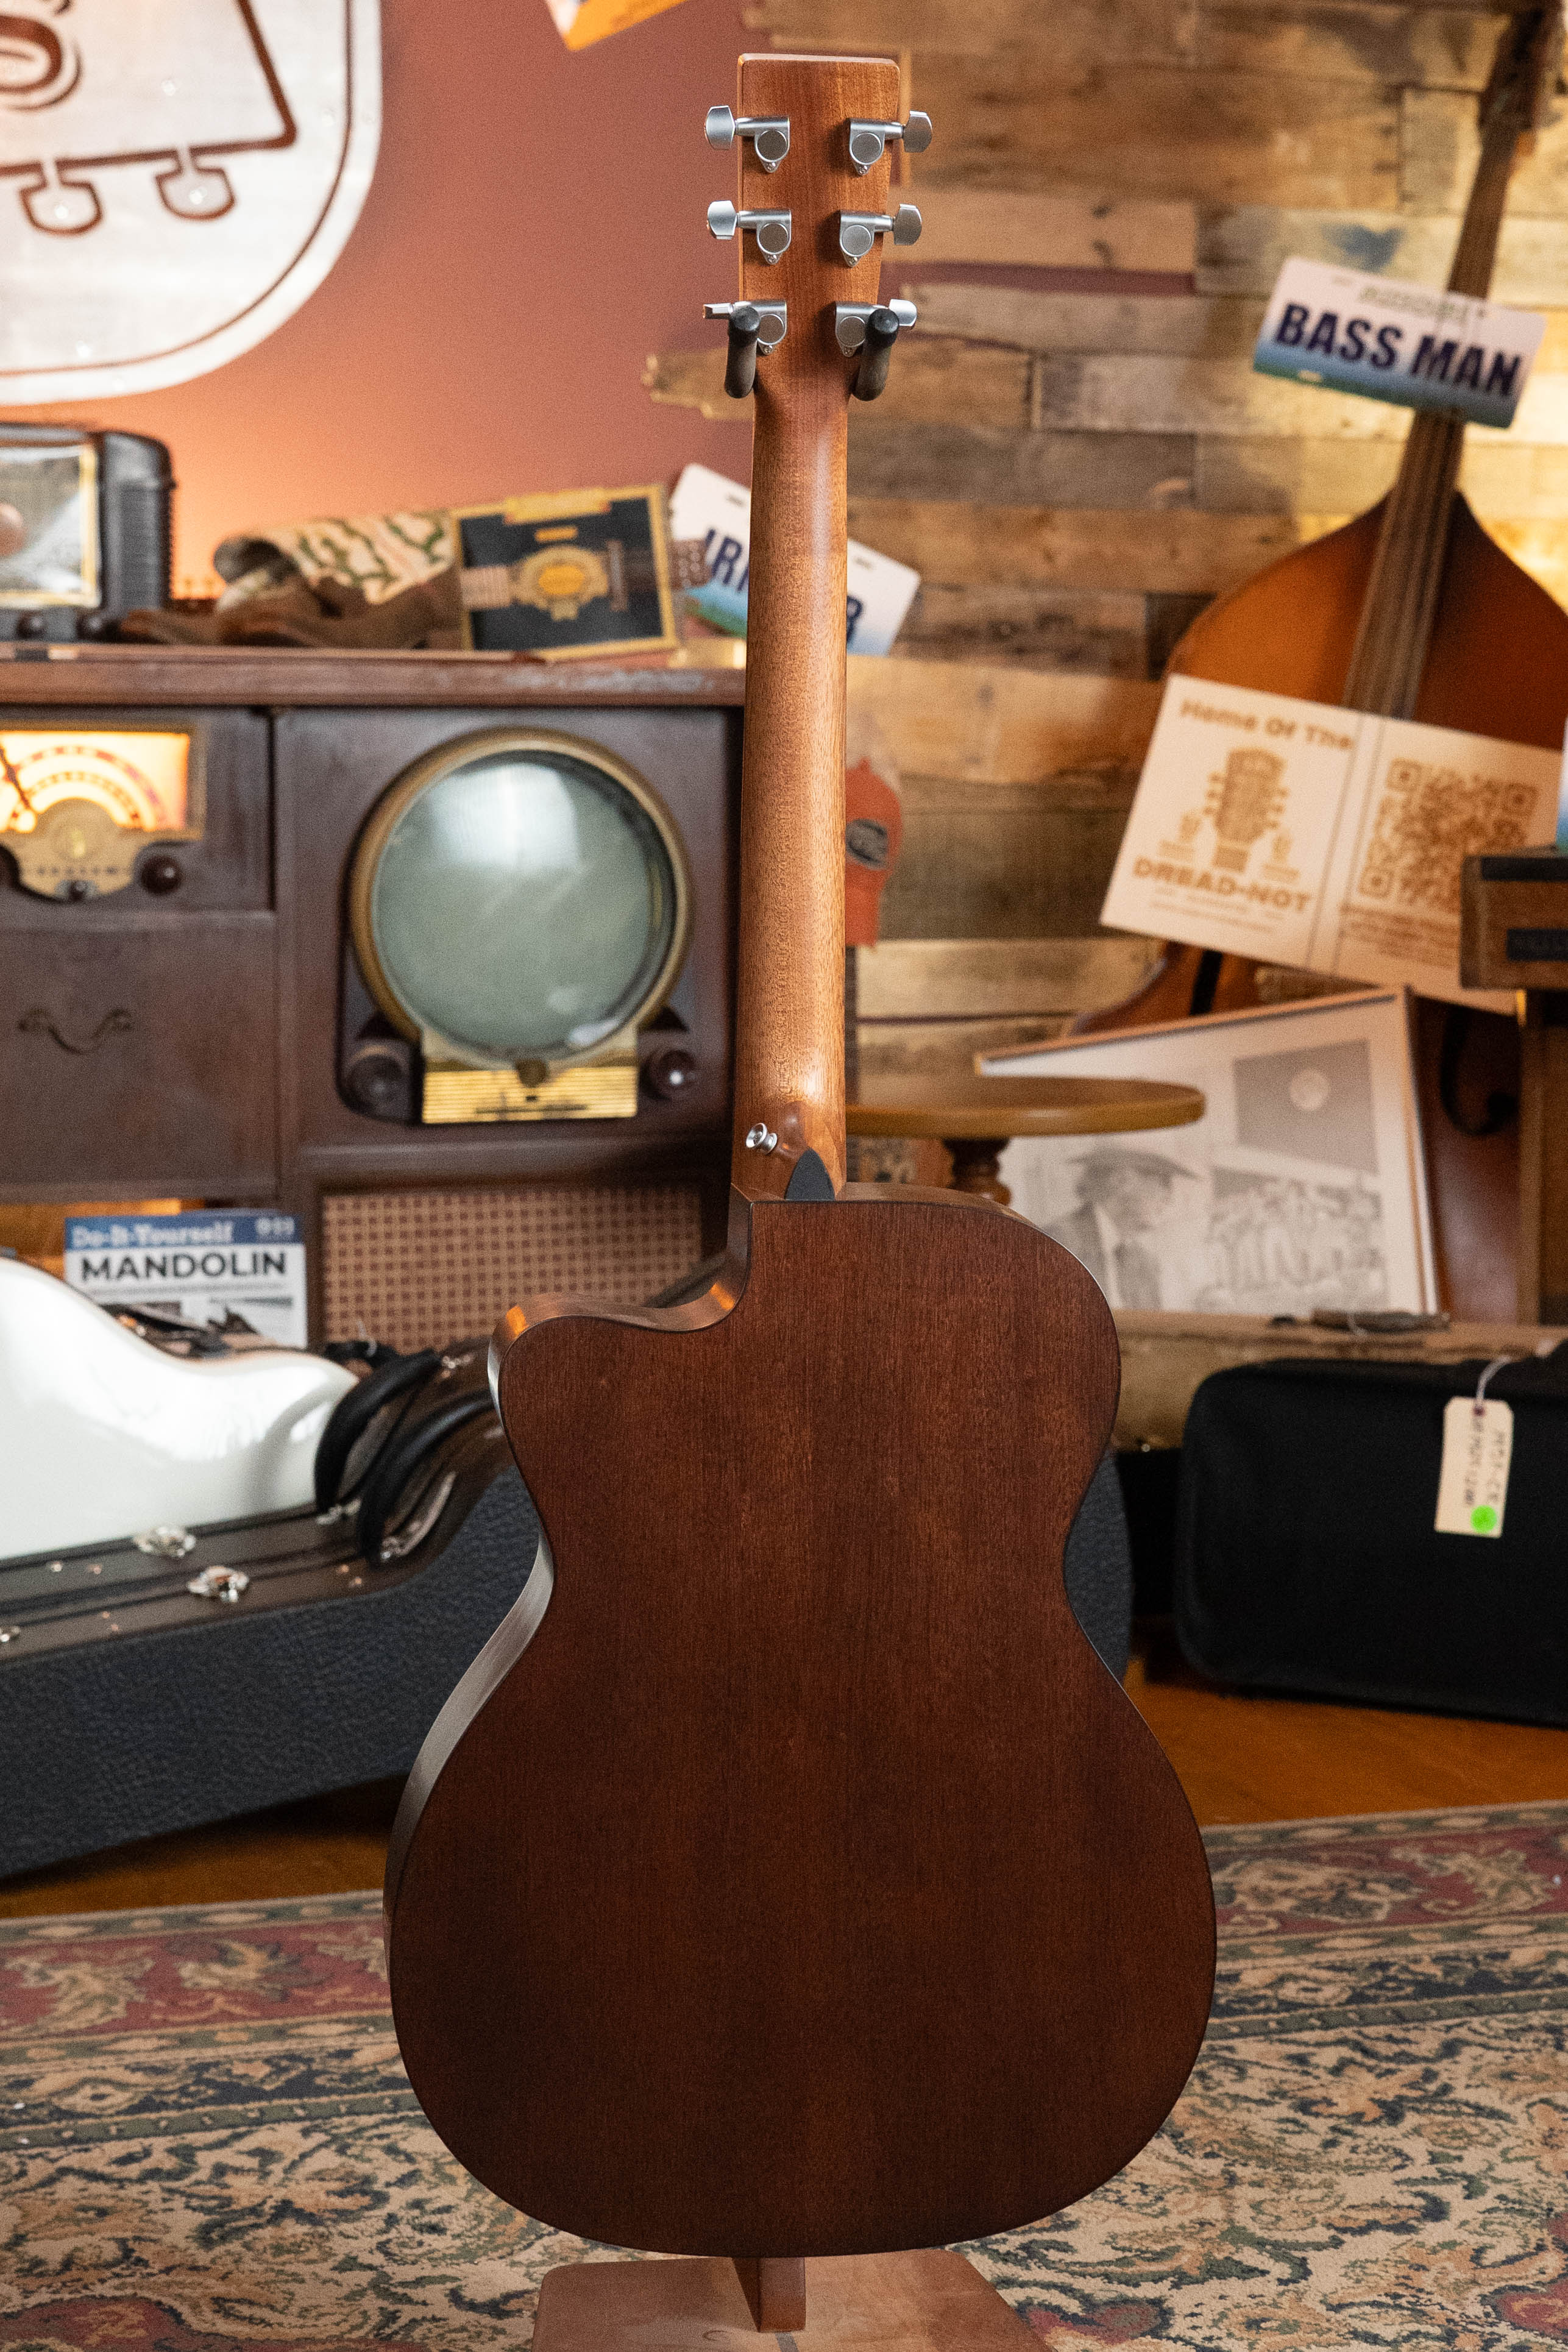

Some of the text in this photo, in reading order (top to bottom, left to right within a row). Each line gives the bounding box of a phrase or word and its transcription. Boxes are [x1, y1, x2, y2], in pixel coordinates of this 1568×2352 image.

[1275, 303, 1403, 370] BASS
[1410, 335, 1521, 396] MAN
[1133, 857, 1312, 911] DREAD-NOT
[82, 1251, 286, 1281] MANDOLIN
